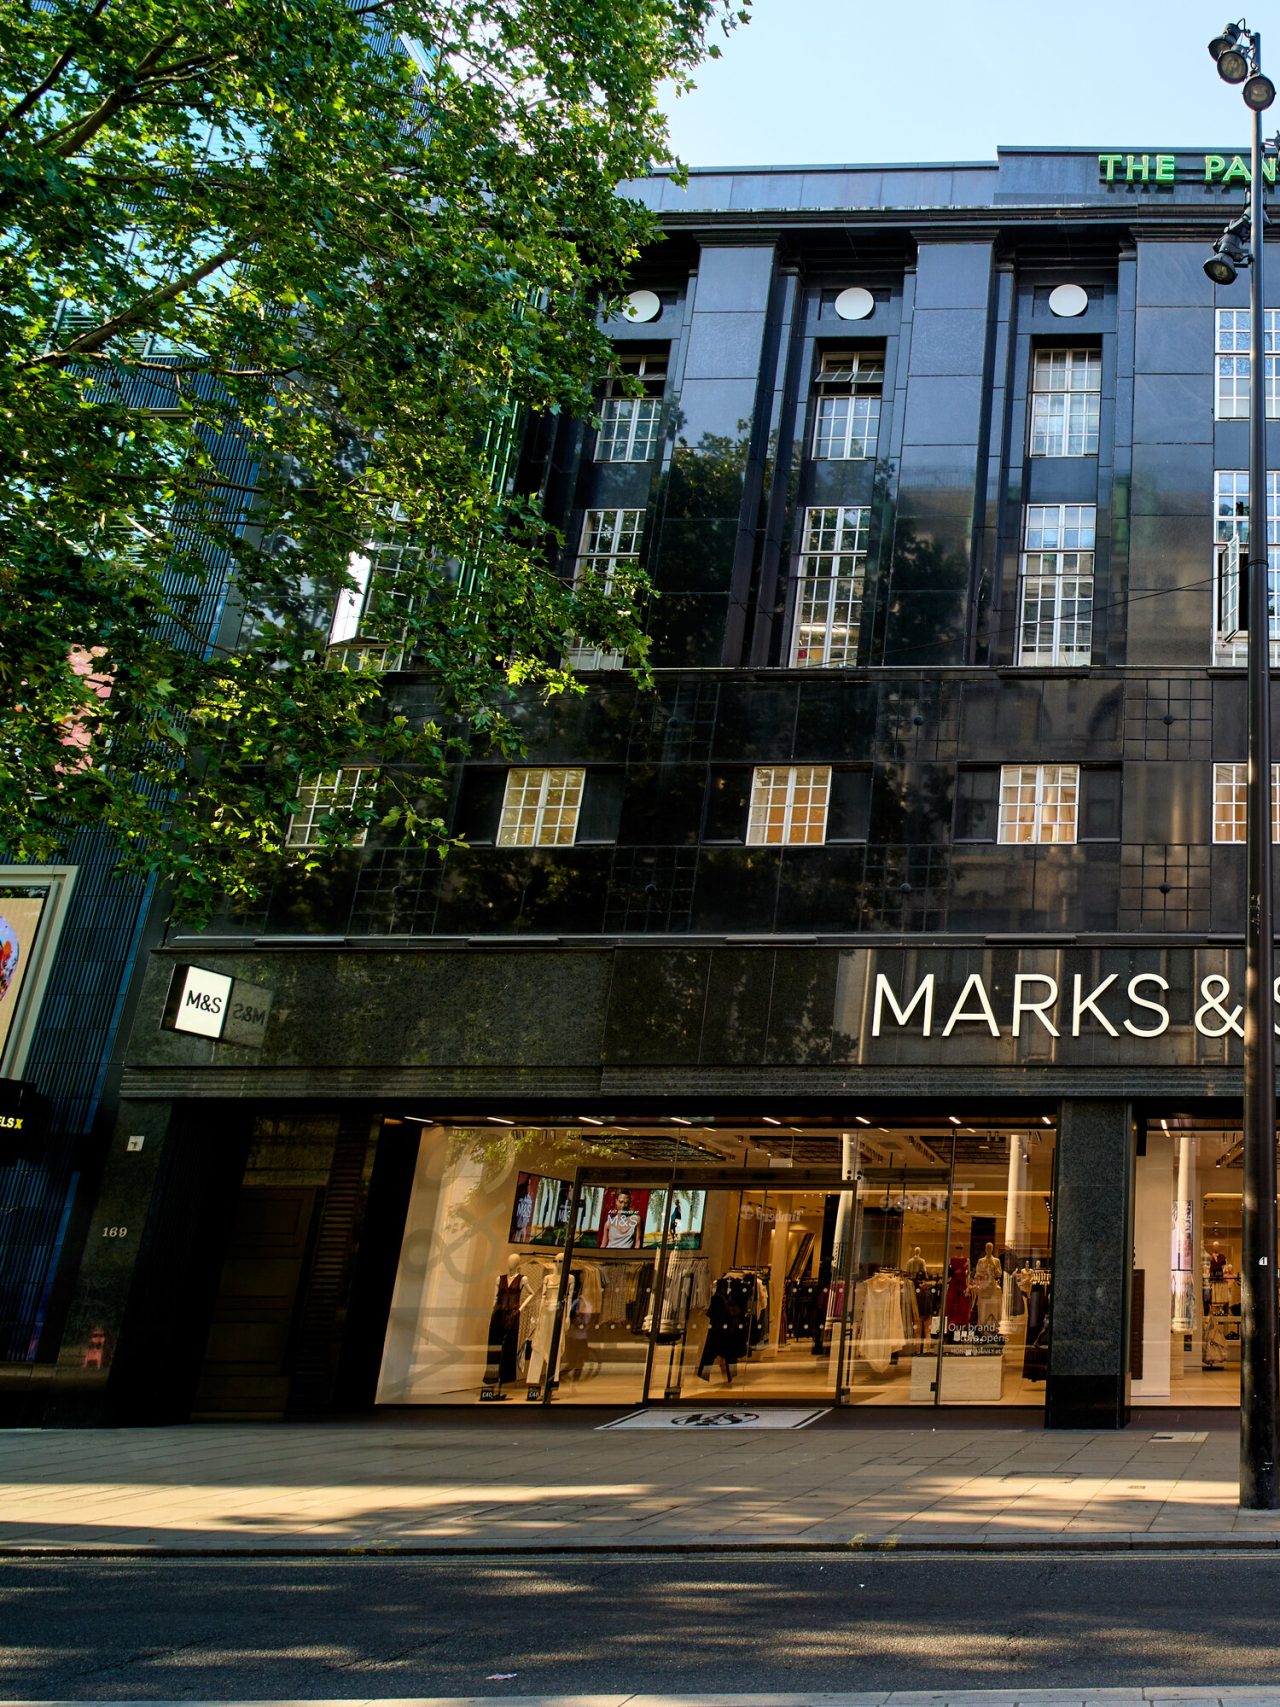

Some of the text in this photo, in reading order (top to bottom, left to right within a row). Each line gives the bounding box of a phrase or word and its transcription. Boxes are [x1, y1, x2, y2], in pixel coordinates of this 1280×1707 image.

[1099, 154, 1175, 182] THE
[186, 990, 222, 1014] M&S
[872, 973, 1170, 1038] MARKS
[1194, 973, 1245, 1038] &
[606, 1214, 638, 1228] M&S
[102, 1226, 128, 1238] 169
[948, 1323, 965, 1332] Our
[982, 1335, 1009, 1344] opens
